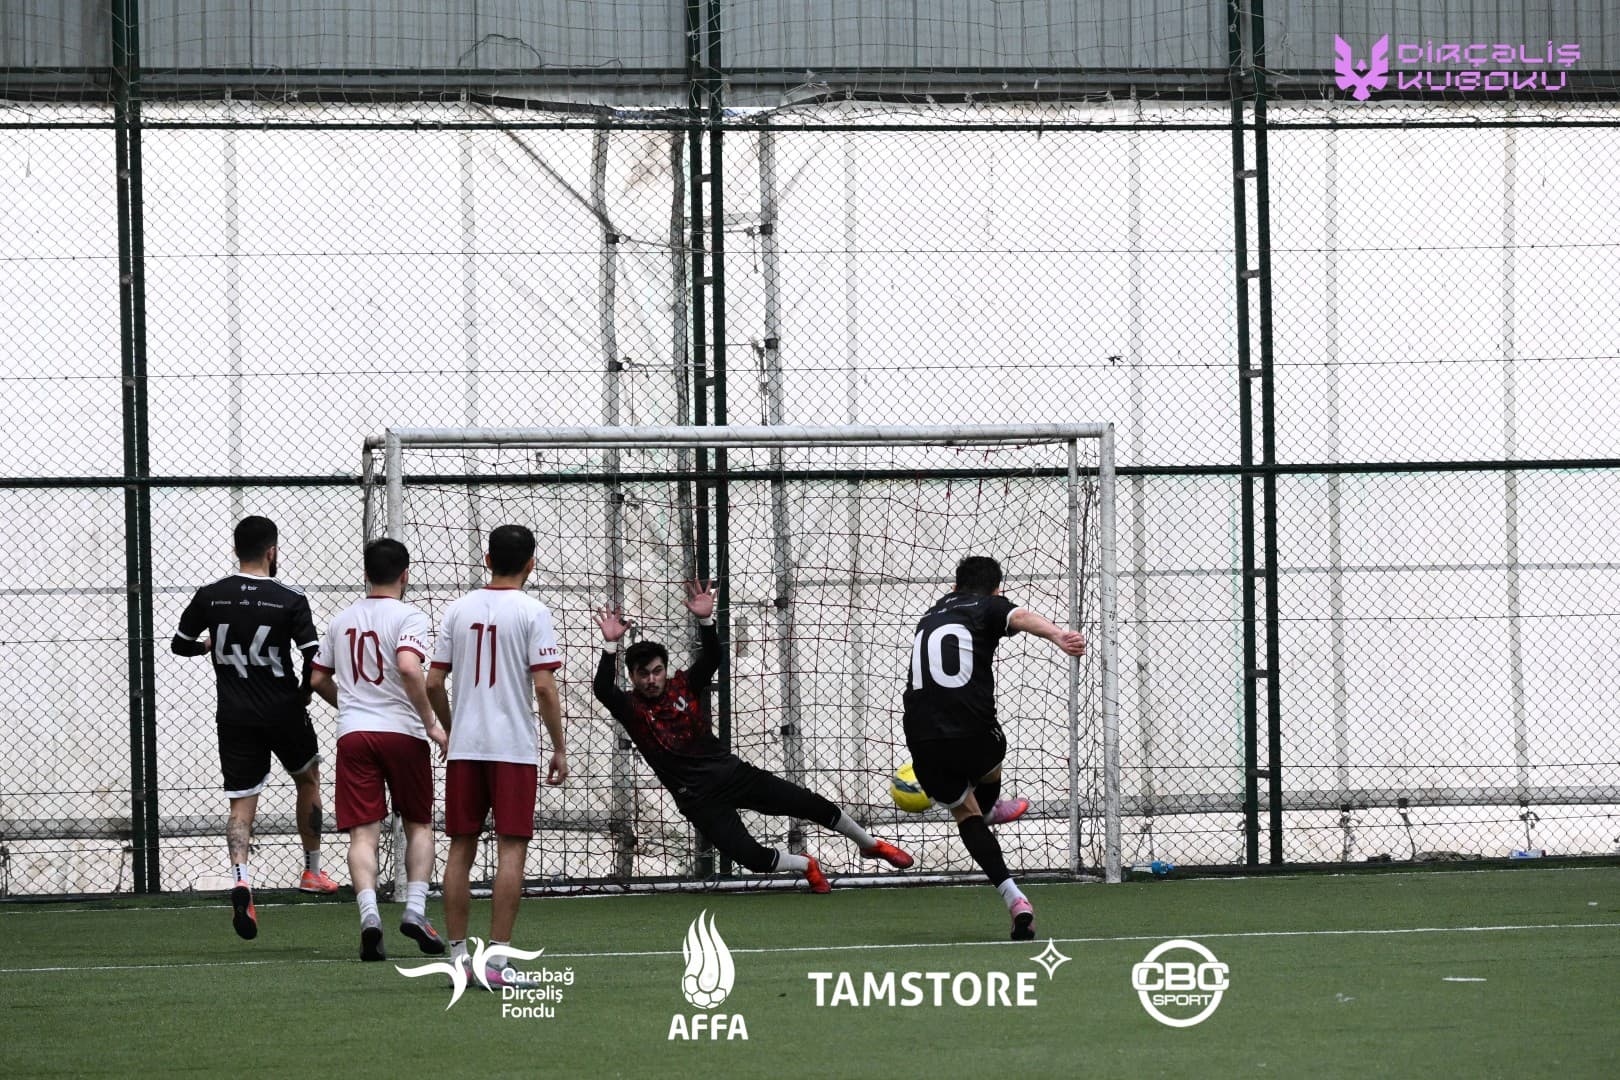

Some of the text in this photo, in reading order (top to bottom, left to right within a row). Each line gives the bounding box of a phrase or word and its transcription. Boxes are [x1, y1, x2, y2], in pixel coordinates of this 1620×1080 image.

[215, 623, 285, 679] 44
[344, 627, 385, 686] 10
[469, 622, 497, 689] 11
[911, 622, 974, 691] 10
